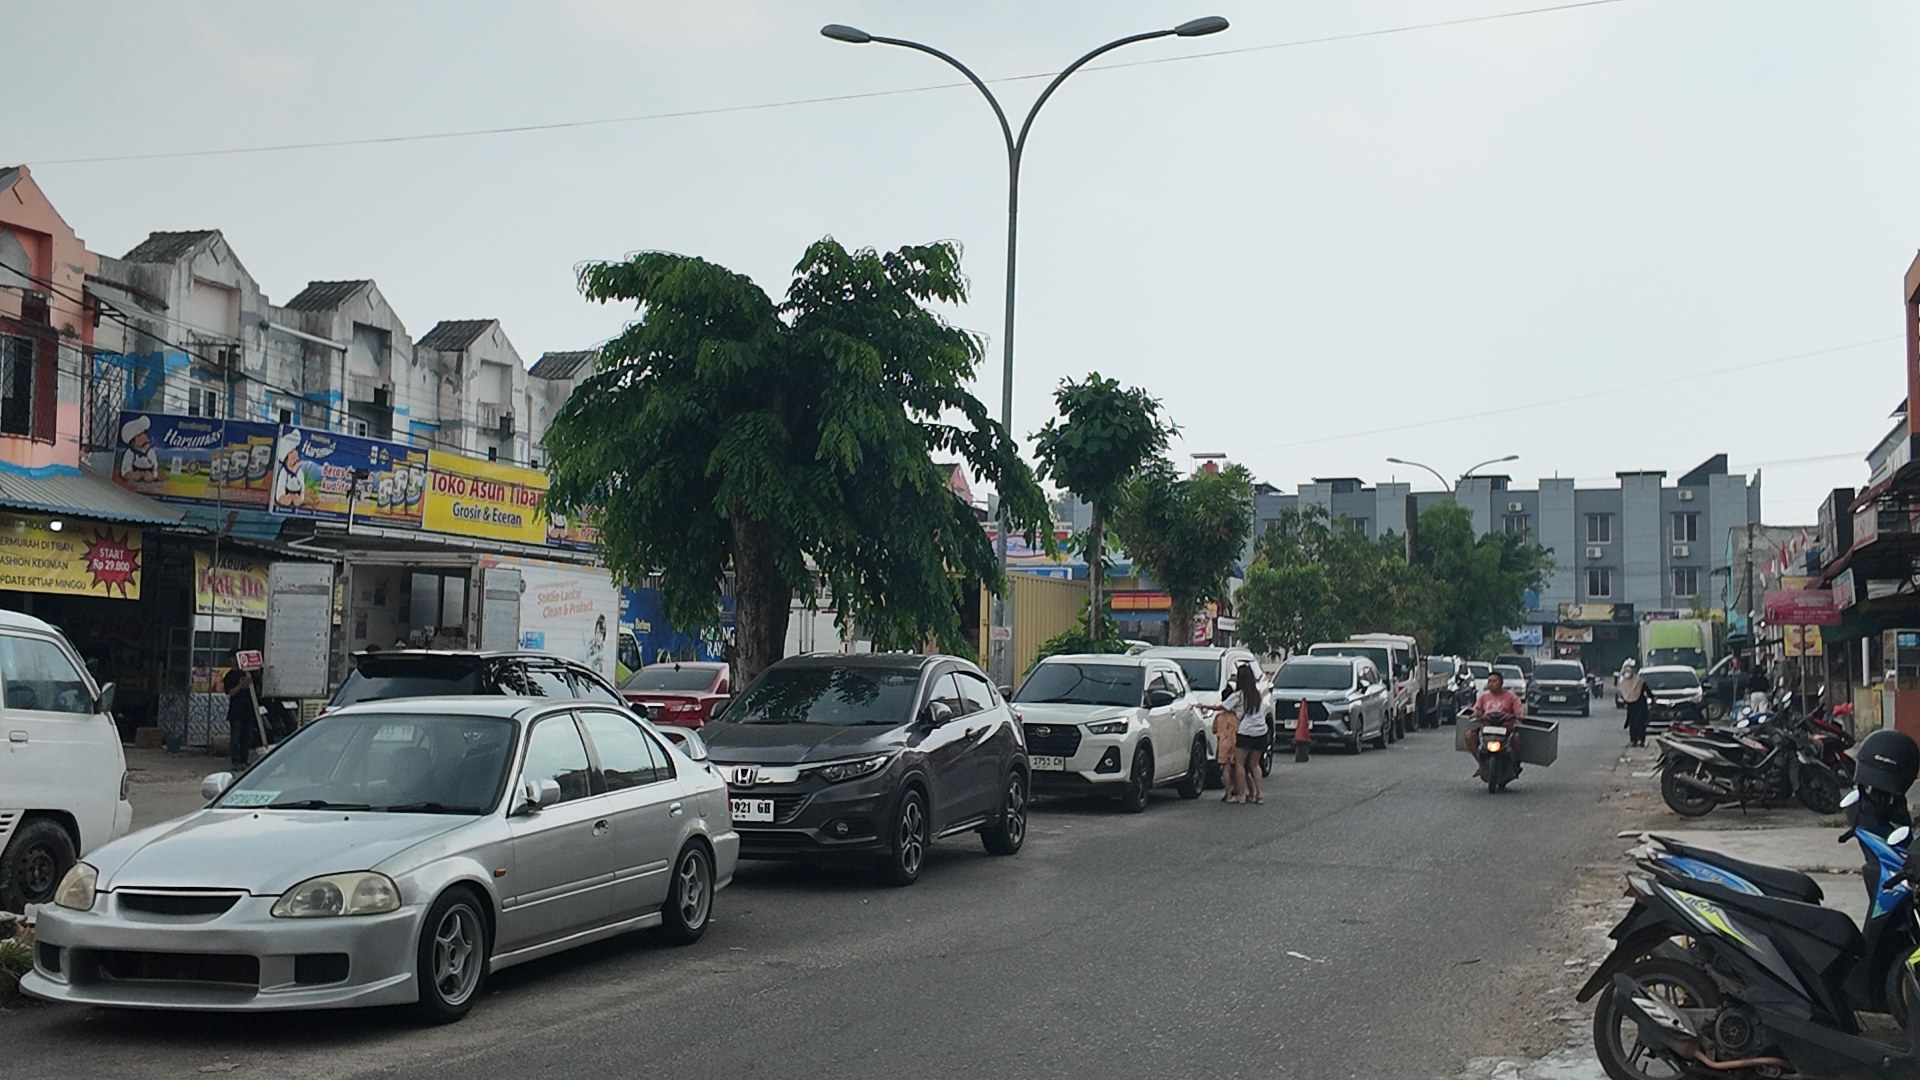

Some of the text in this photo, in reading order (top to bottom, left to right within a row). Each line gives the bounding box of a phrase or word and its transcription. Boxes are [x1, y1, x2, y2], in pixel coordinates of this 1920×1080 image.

[431, 469, 466, 495] Toko
[469, 476, 505, 502] Asun
[452, 501, 522, 526] Grosir & Eceran
[99, 548, 124, 560] START
